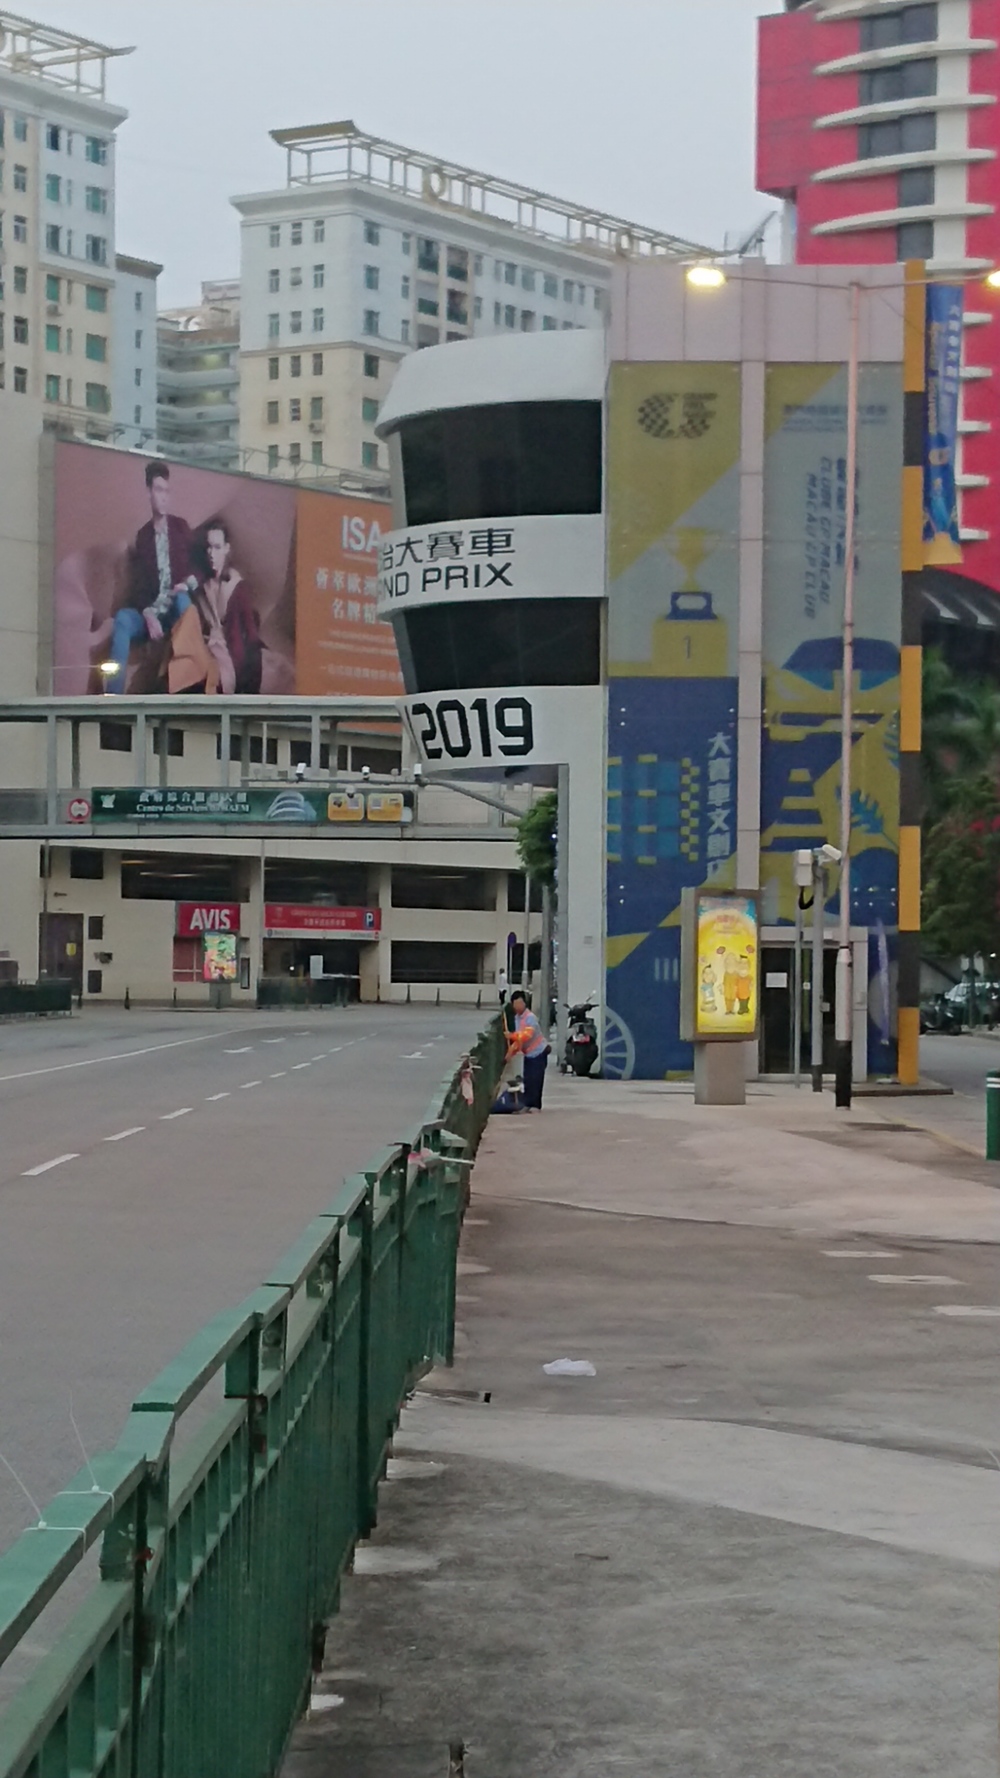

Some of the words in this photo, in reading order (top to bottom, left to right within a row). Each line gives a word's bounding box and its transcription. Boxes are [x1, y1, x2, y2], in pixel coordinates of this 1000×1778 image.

[421, 562, 514, 592] PRIX
[411, 697, 534, 759] 2019
[190, 907, 231, 930] AVIS
[366, 912, 374, 927] P
